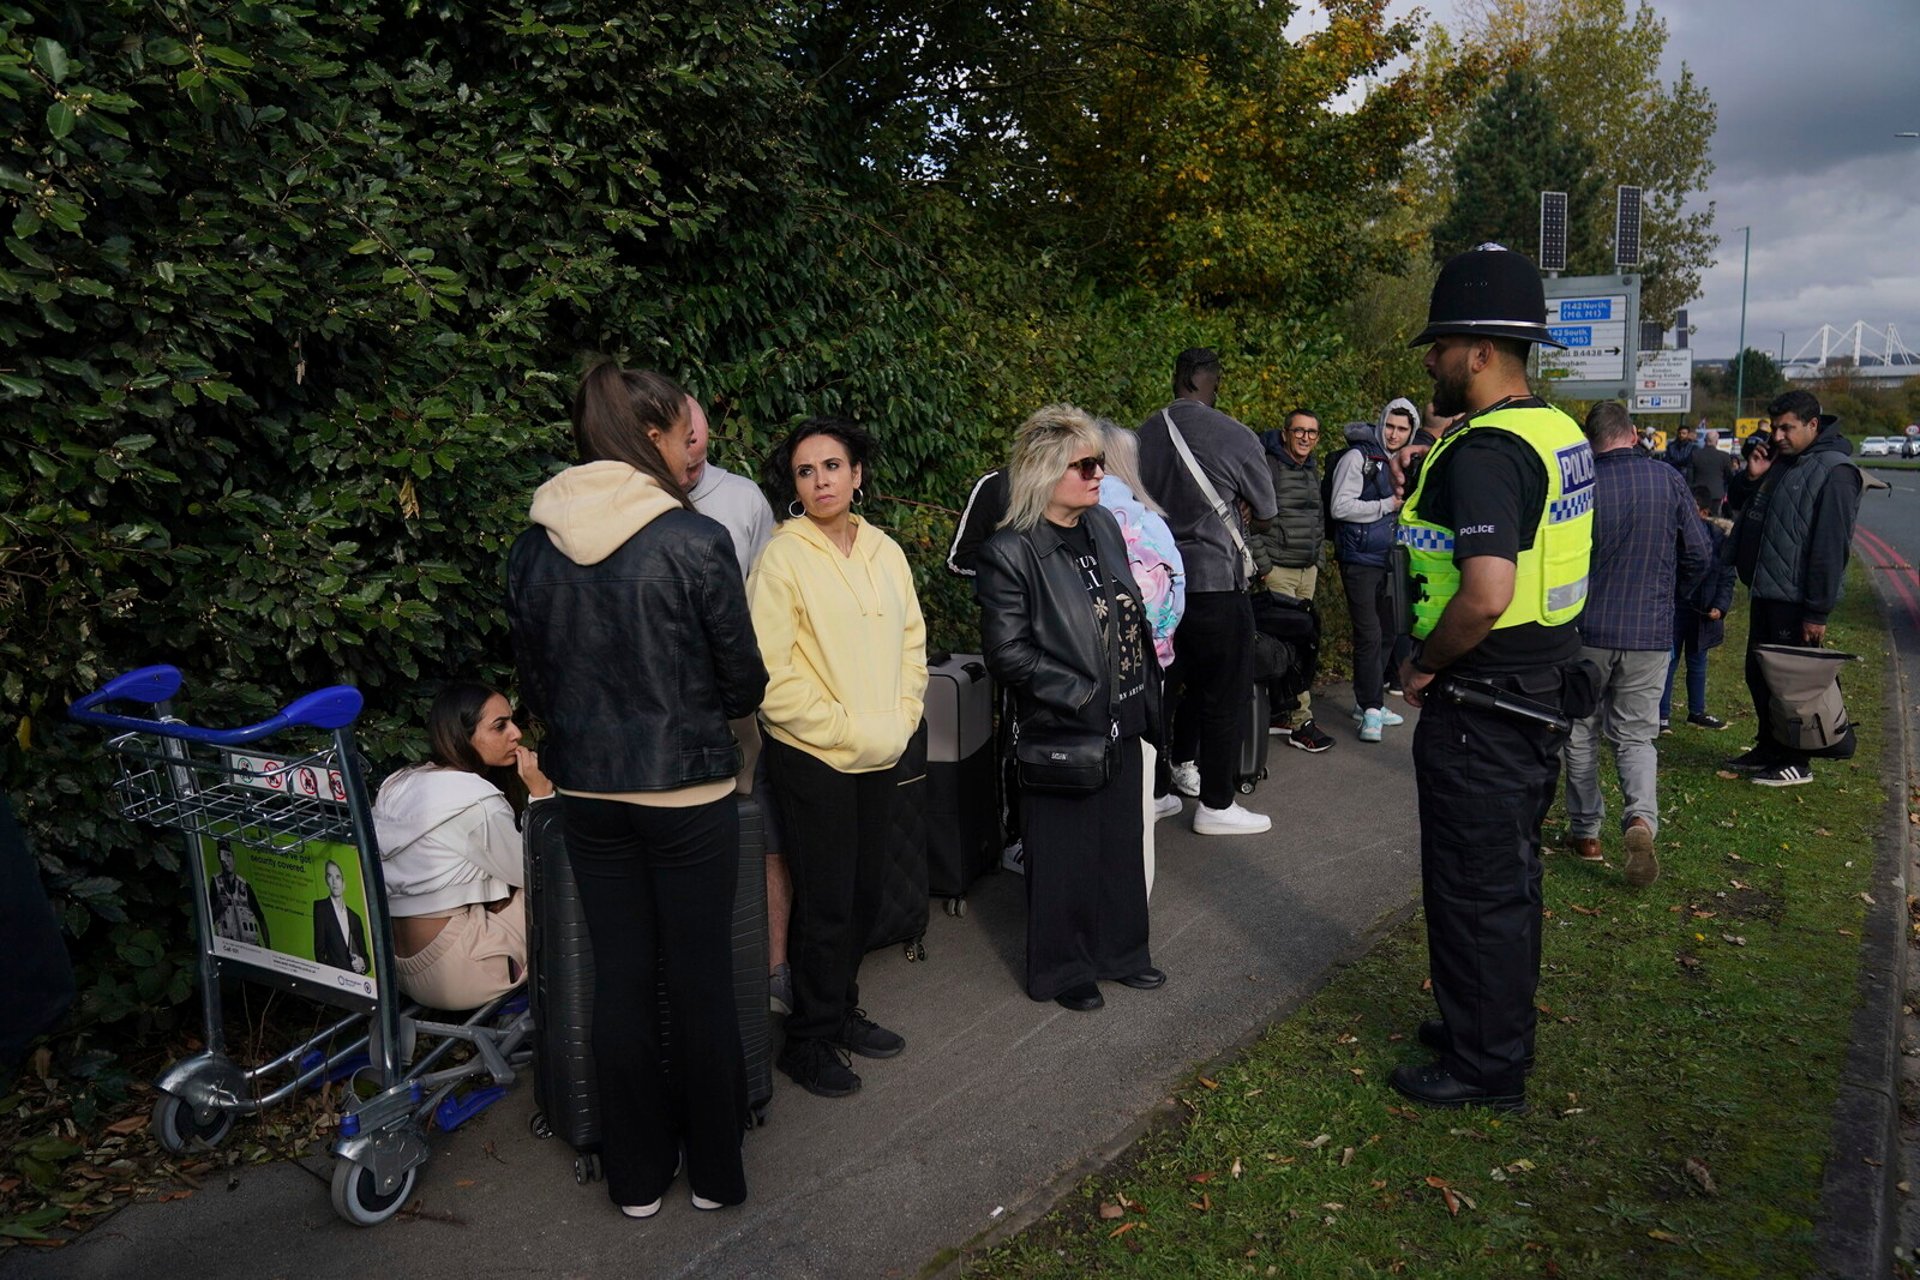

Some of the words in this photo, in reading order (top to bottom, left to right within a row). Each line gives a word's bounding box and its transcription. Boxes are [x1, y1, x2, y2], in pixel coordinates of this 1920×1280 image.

[1541, 360, 1587, 368] Bingham
[1560, 449, 1595, 488] POLIC
[1459, 525, 1495, 536] POLICE
